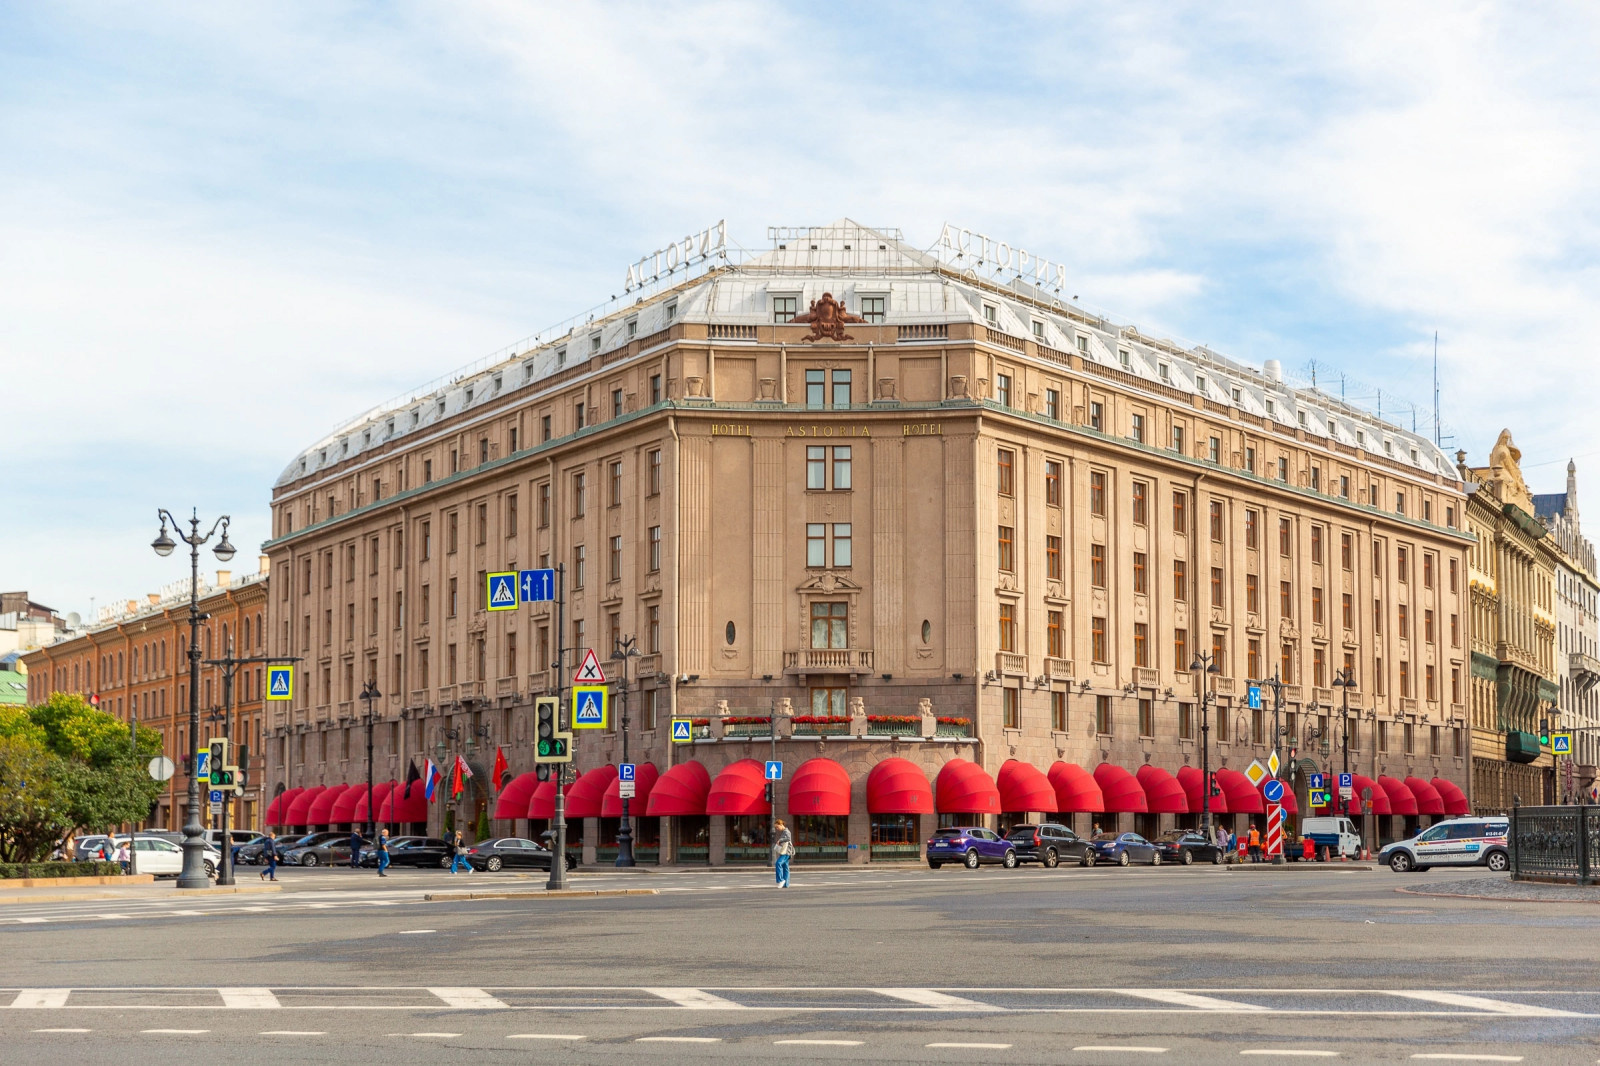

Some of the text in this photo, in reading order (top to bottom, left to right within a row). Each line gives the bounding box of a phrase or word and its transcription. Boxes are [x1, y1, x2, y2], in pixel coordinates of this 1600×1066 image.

[625, 218, 727, 289] АСТОРИЯ
[938, 220, 1066, 290] АСТОРИЯ
[711, 424, 944, 437] HOTEL ASTORIA HOTEL
